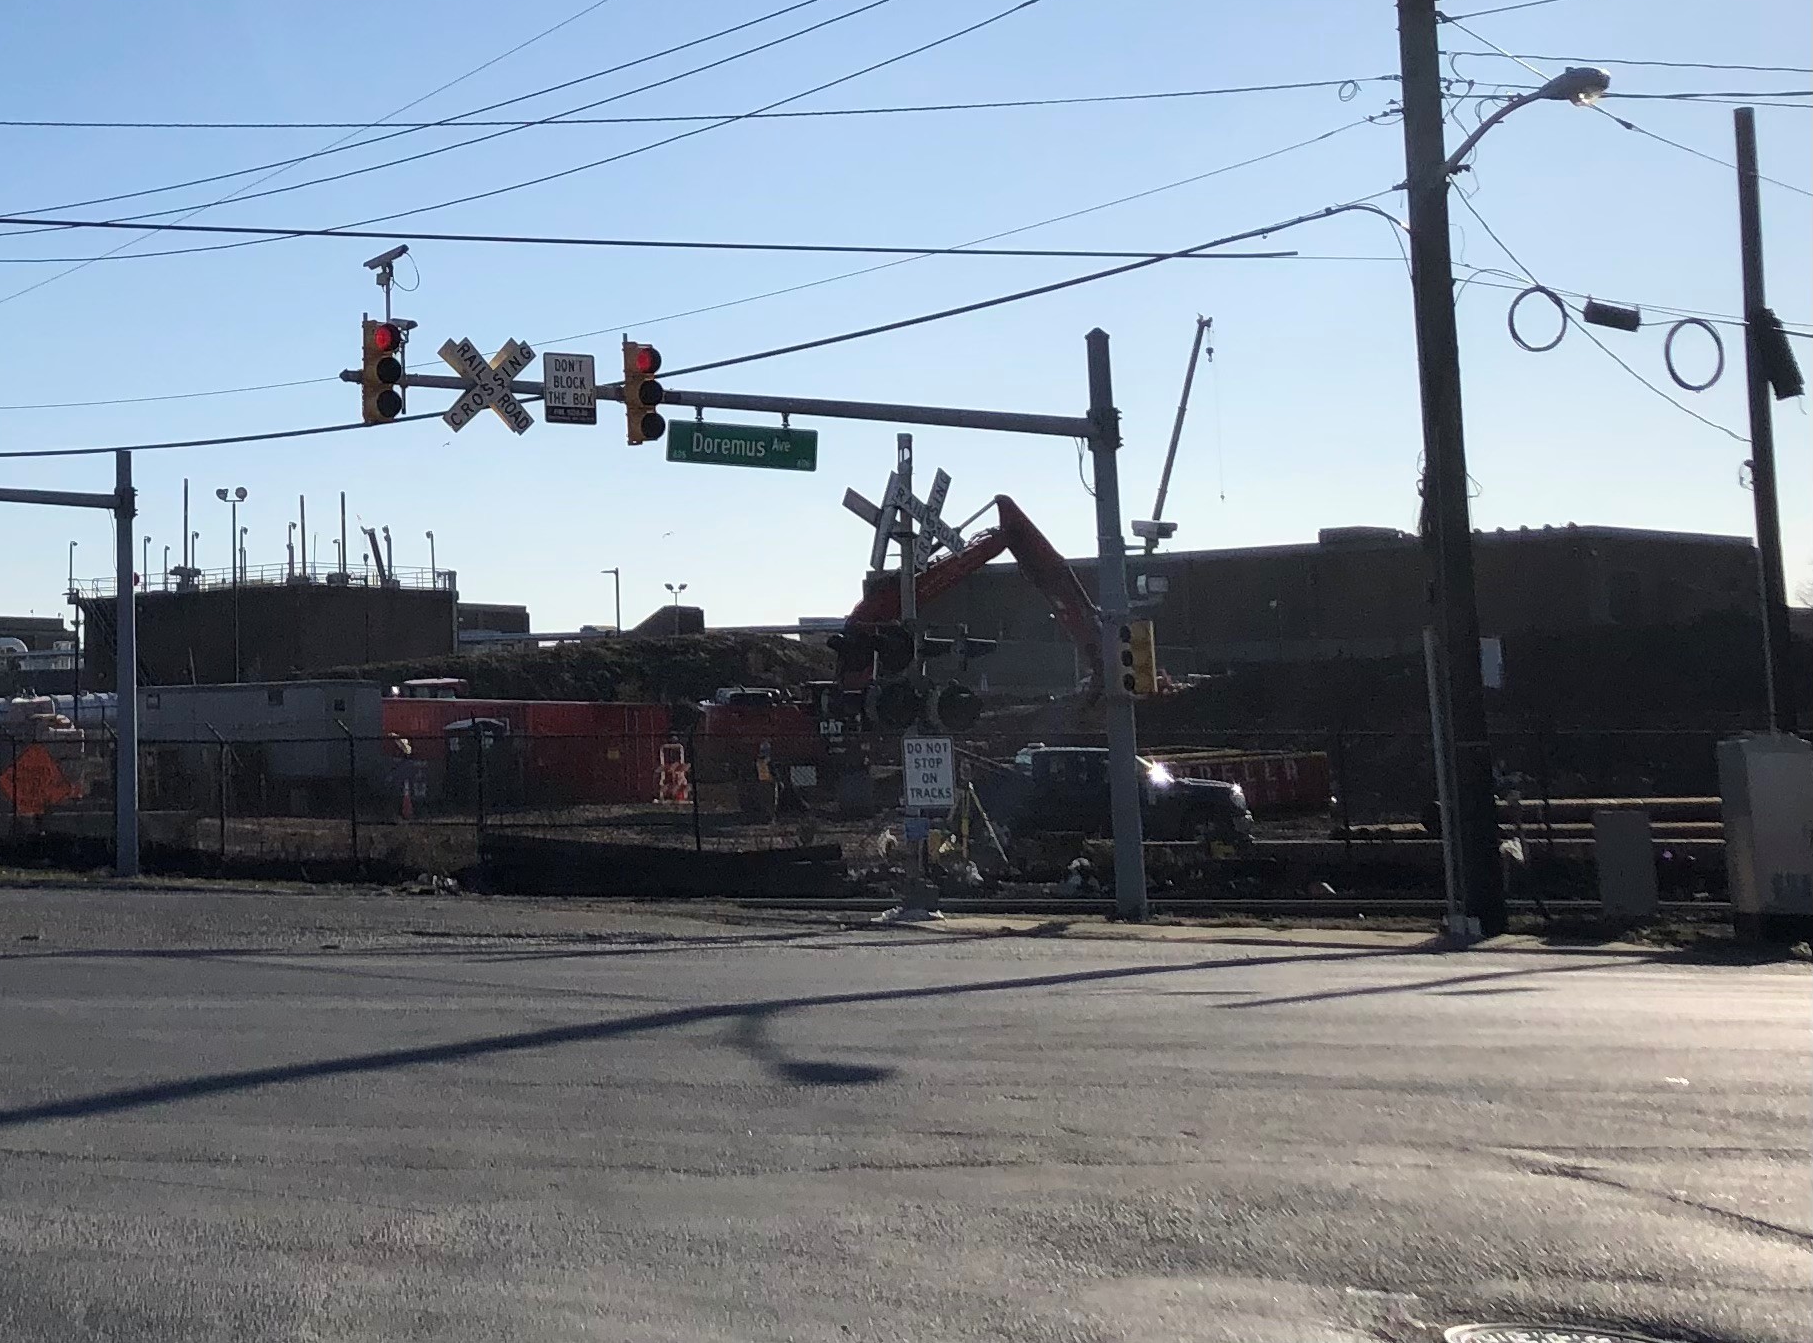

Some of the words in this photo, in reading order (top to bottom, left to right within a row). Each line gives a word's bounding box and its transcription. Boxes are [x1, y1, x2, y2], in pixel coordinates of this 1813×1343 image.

[554, 358, 583, 372] DON'T
[450, 346, 531, 426] CROSSING
[553, 375, 586, 389] BLOCK
[548, 391, 567, 405] THE
[573, 392, 593, 406] BOX
[692, 432, 765, 457] Doremus
[772, 437, 791, 452] Ave
[819, 720, 844, 734] CAT
[907, 742, 922, 754] DO
[926, 742, 948, 754] NOT
[914, 757, 943, 769] STOP
[921, 772, 938, 784] ON
[909, 787, 952, 799] TRACKS
